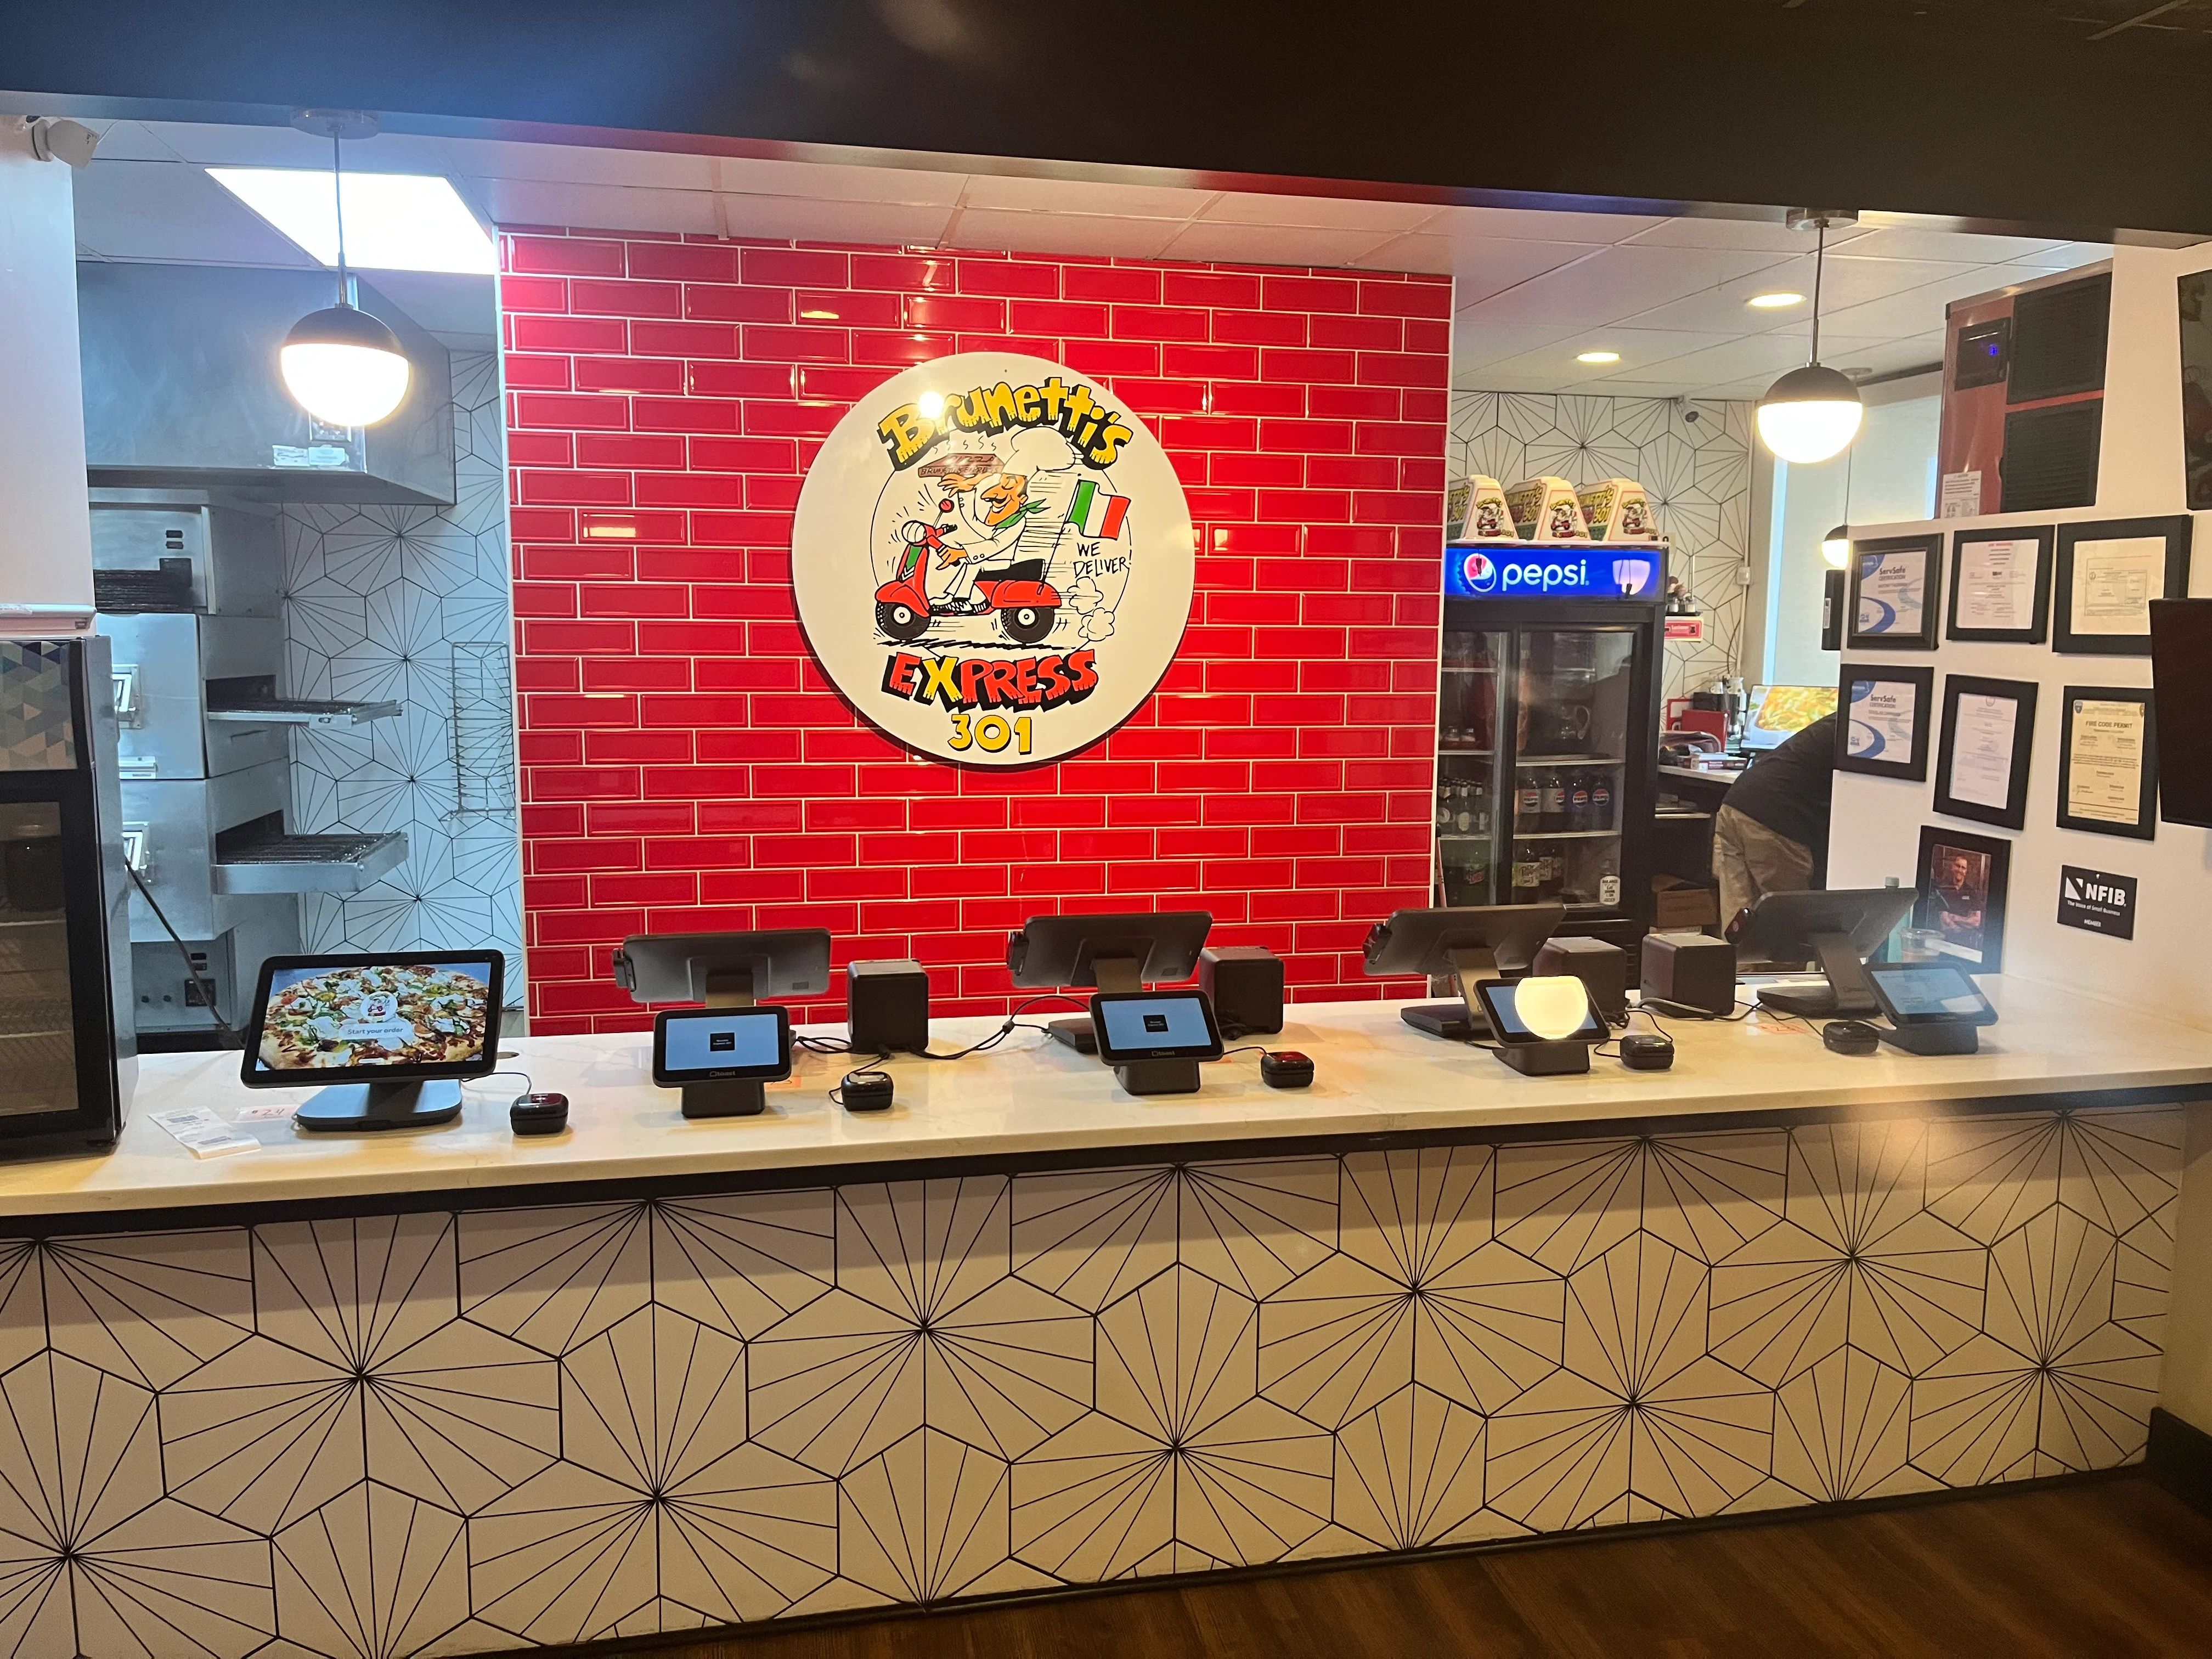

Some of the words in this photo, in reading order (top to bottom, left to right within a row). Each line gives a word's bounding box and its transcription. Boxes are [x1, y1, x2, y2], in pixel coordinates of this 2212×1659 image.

[877, 376, 1133, 471] Brunetti's
[1077, 541, 1101, 556] WE
[1502, 559, 1587, 591] pepsi
[1879, 565, 1906, 575] ServSafe
[881, 649, 1098, 713] EXPRESS
[1870, 694, 1897, 703] ServSafe
[947, 714, 1032, 755] 301
[2086, 883, 2125, 906] NFIB
